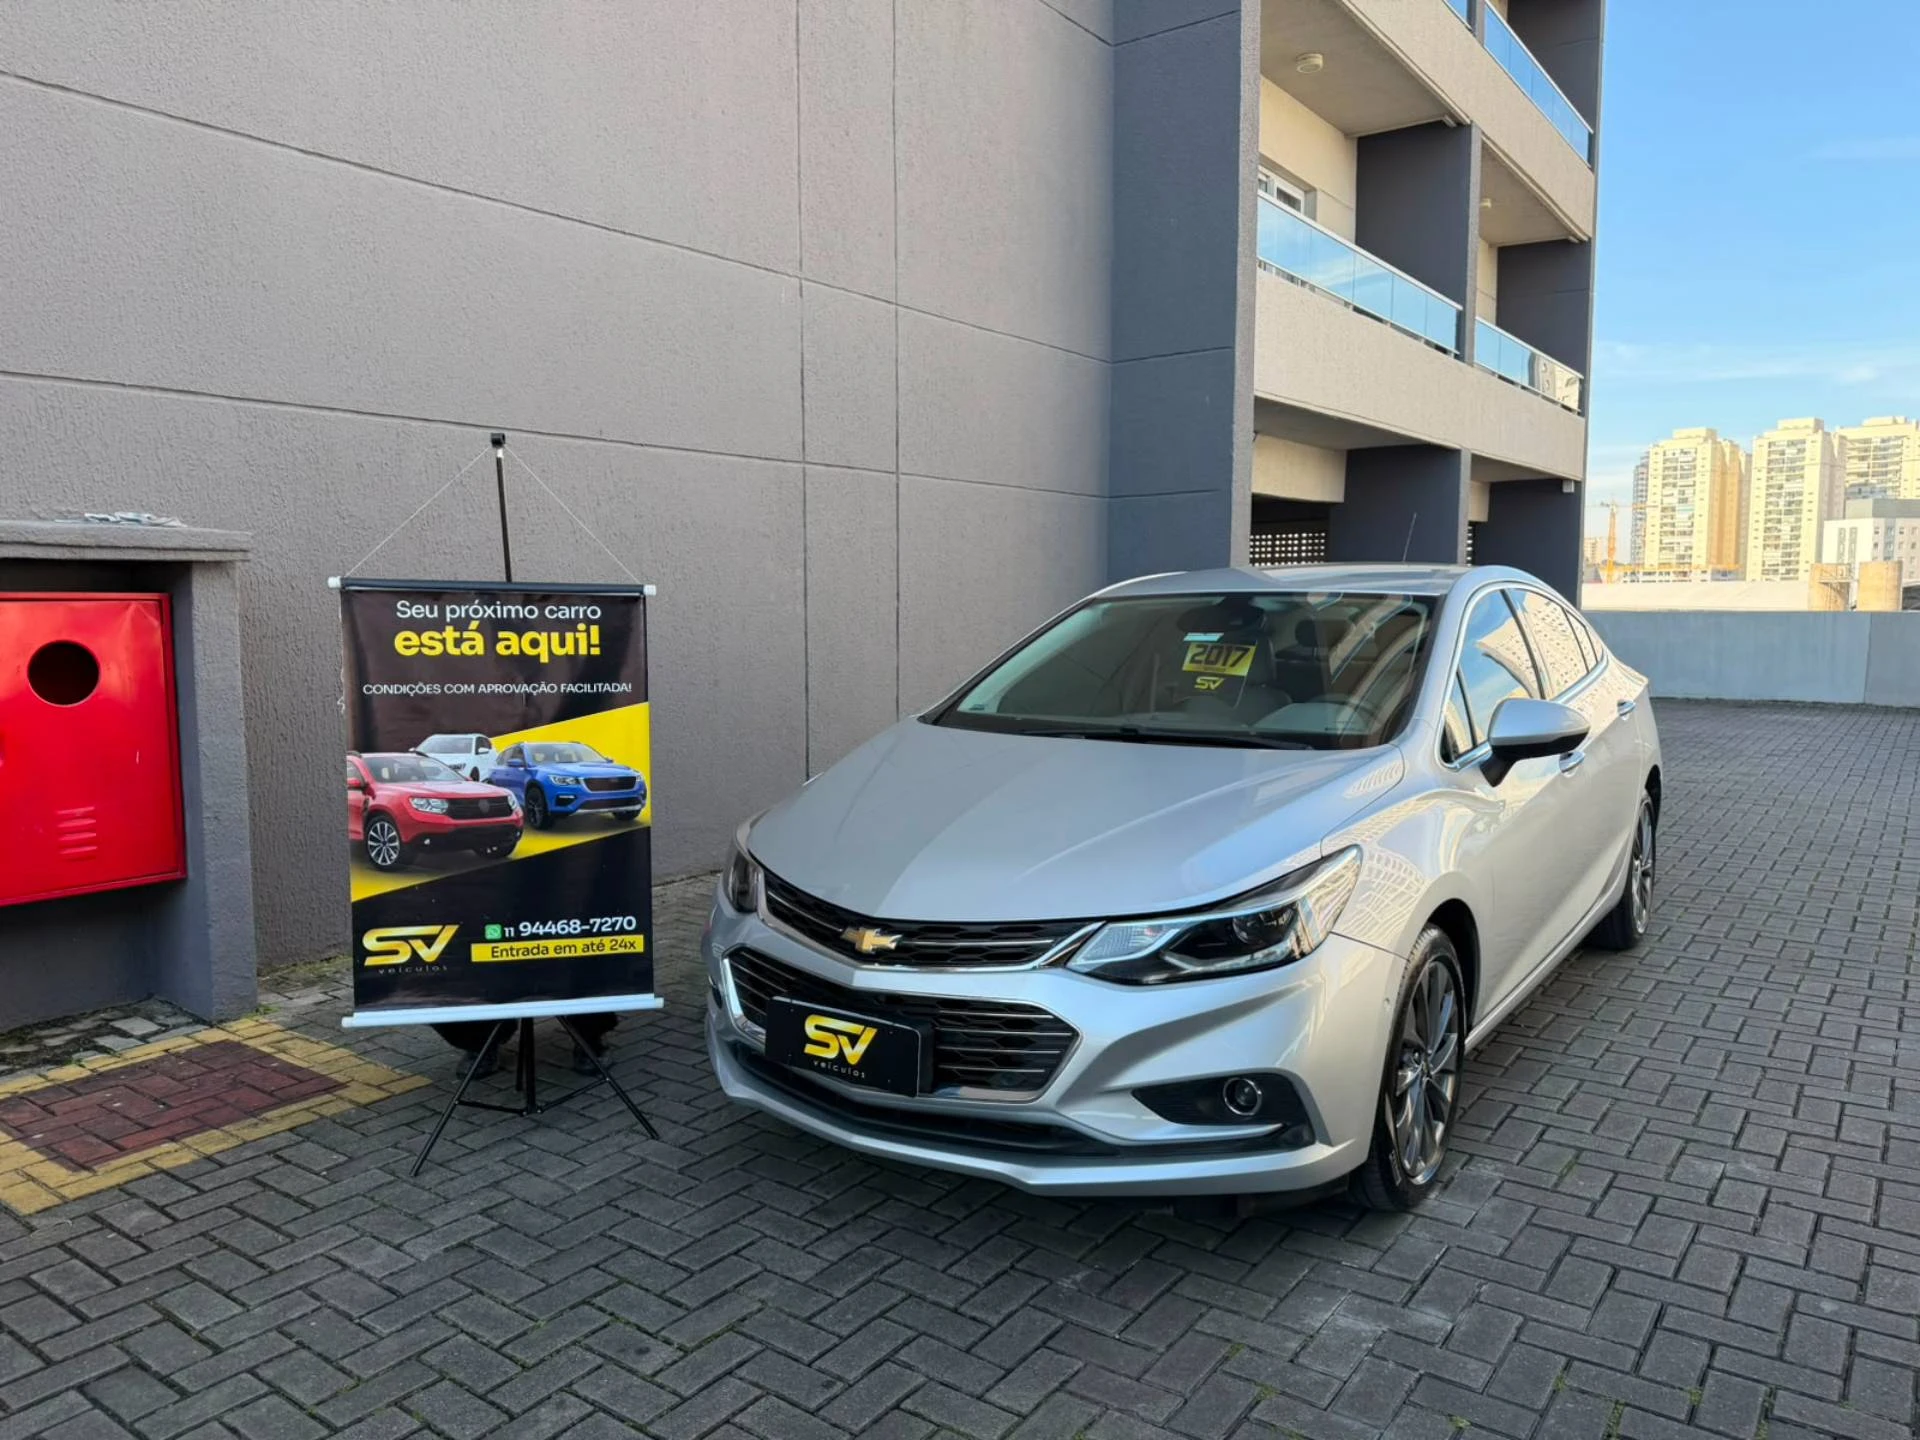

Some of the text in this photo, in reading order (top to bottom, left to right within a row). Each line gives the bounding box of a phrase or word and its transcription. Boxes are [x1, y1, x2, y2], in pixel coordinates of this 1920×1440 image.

[396, 599, 602, 622] Seu próximo carro
[394, 620, 602, 664] está aqui!
[1189, 643, 1251, 668] 2017
[362, 681, 632, 697] CONDIÇÕES COM APROVAÇÃO FACILITADA!
[1194, 676, 1225, 690] SV
[518, 915, 637, 938] 94468-7270
[362, 924, 461, 967] SV
[491, 938, 637, 959] Entrada em até 24x
[804, 1014, 878, 1065] SV
